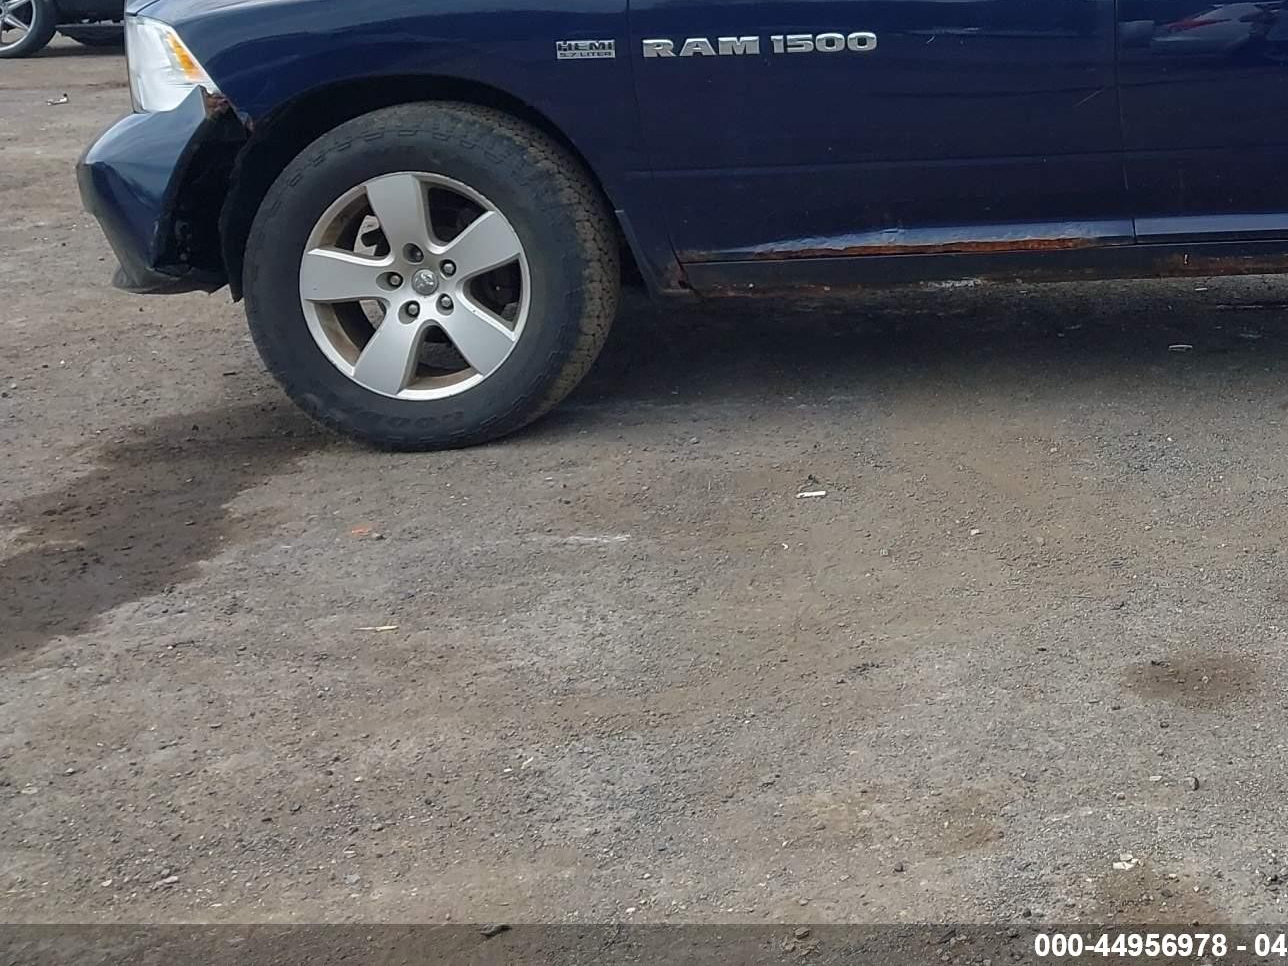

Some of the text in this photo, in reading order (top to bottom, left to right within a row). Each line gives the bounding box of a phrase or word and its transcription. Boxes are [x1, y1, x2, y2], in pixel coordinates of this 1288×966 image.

[557, 40, 614, 51] HEMI
[642, 32, 877, 57] RAM 1500
